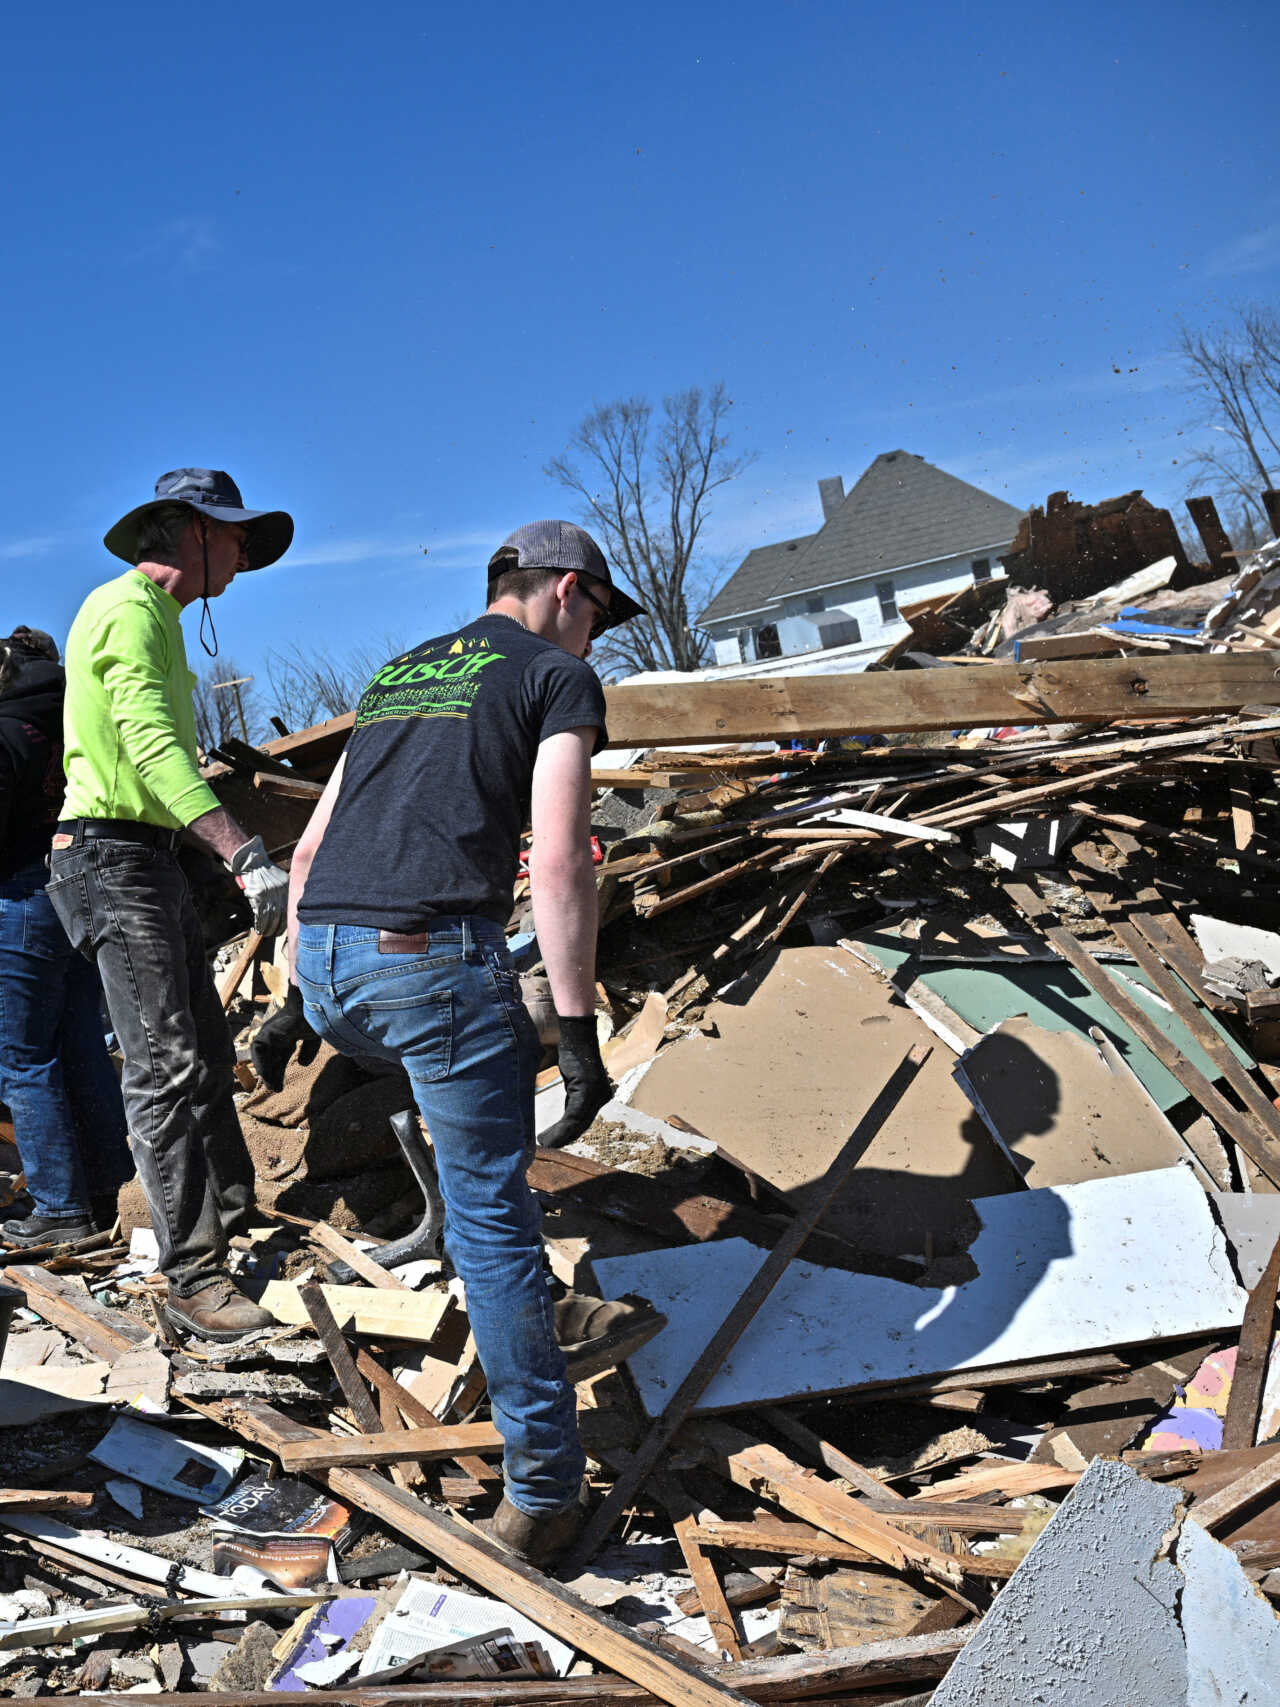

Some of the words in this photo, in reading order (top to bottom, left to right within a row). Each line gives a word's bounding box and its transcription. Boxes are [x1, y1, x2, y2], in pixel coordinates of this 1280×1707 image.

[219, 1481, 275, 1518] TODAY
[243, 1549, 259, 1559] the
[260, 1553, 283, 1562] Trust
